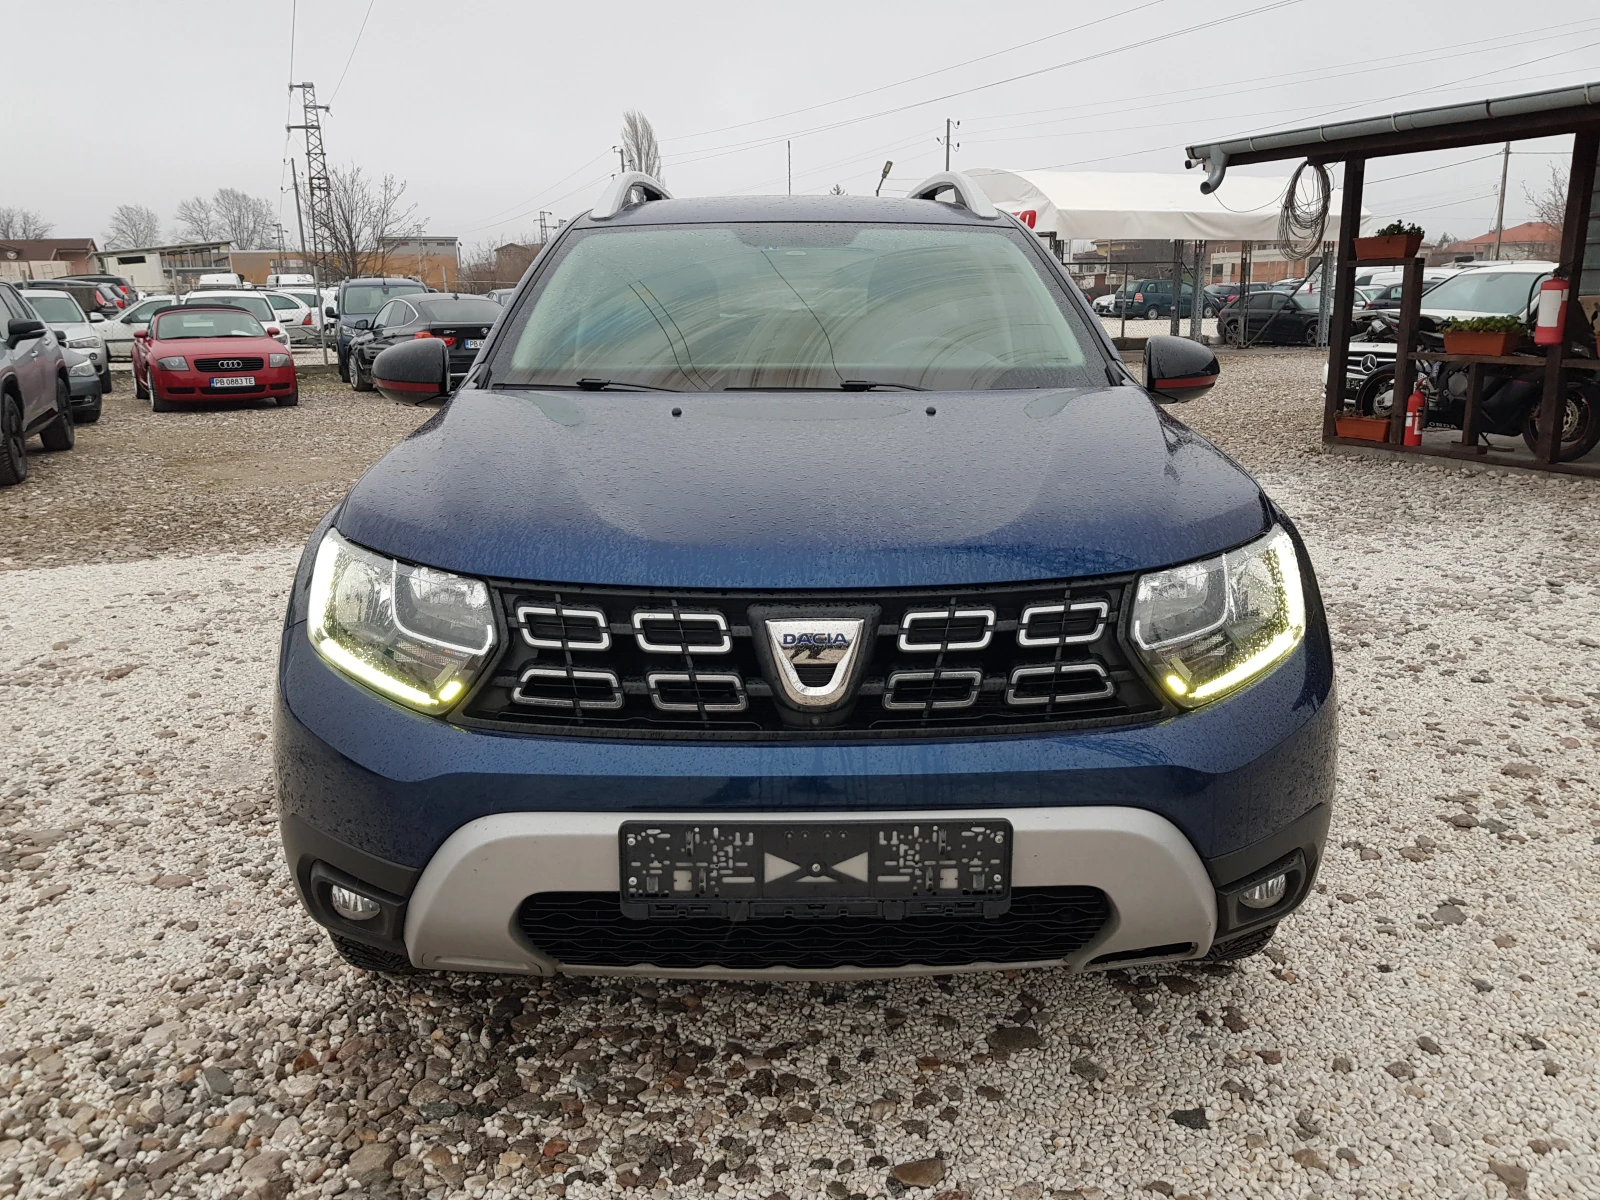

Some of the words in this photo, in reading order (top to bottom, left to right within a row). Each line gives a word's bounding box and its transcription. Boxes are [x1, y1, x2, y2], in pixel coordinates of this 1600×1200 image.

[469, 340, 479, 348] PB
[226, 378, 243, 386] 0883
[244, 377, 254, 385] TE
[1428, 421, 1458, 429] ONDA
[783, 633, 848, 645] DACIA
